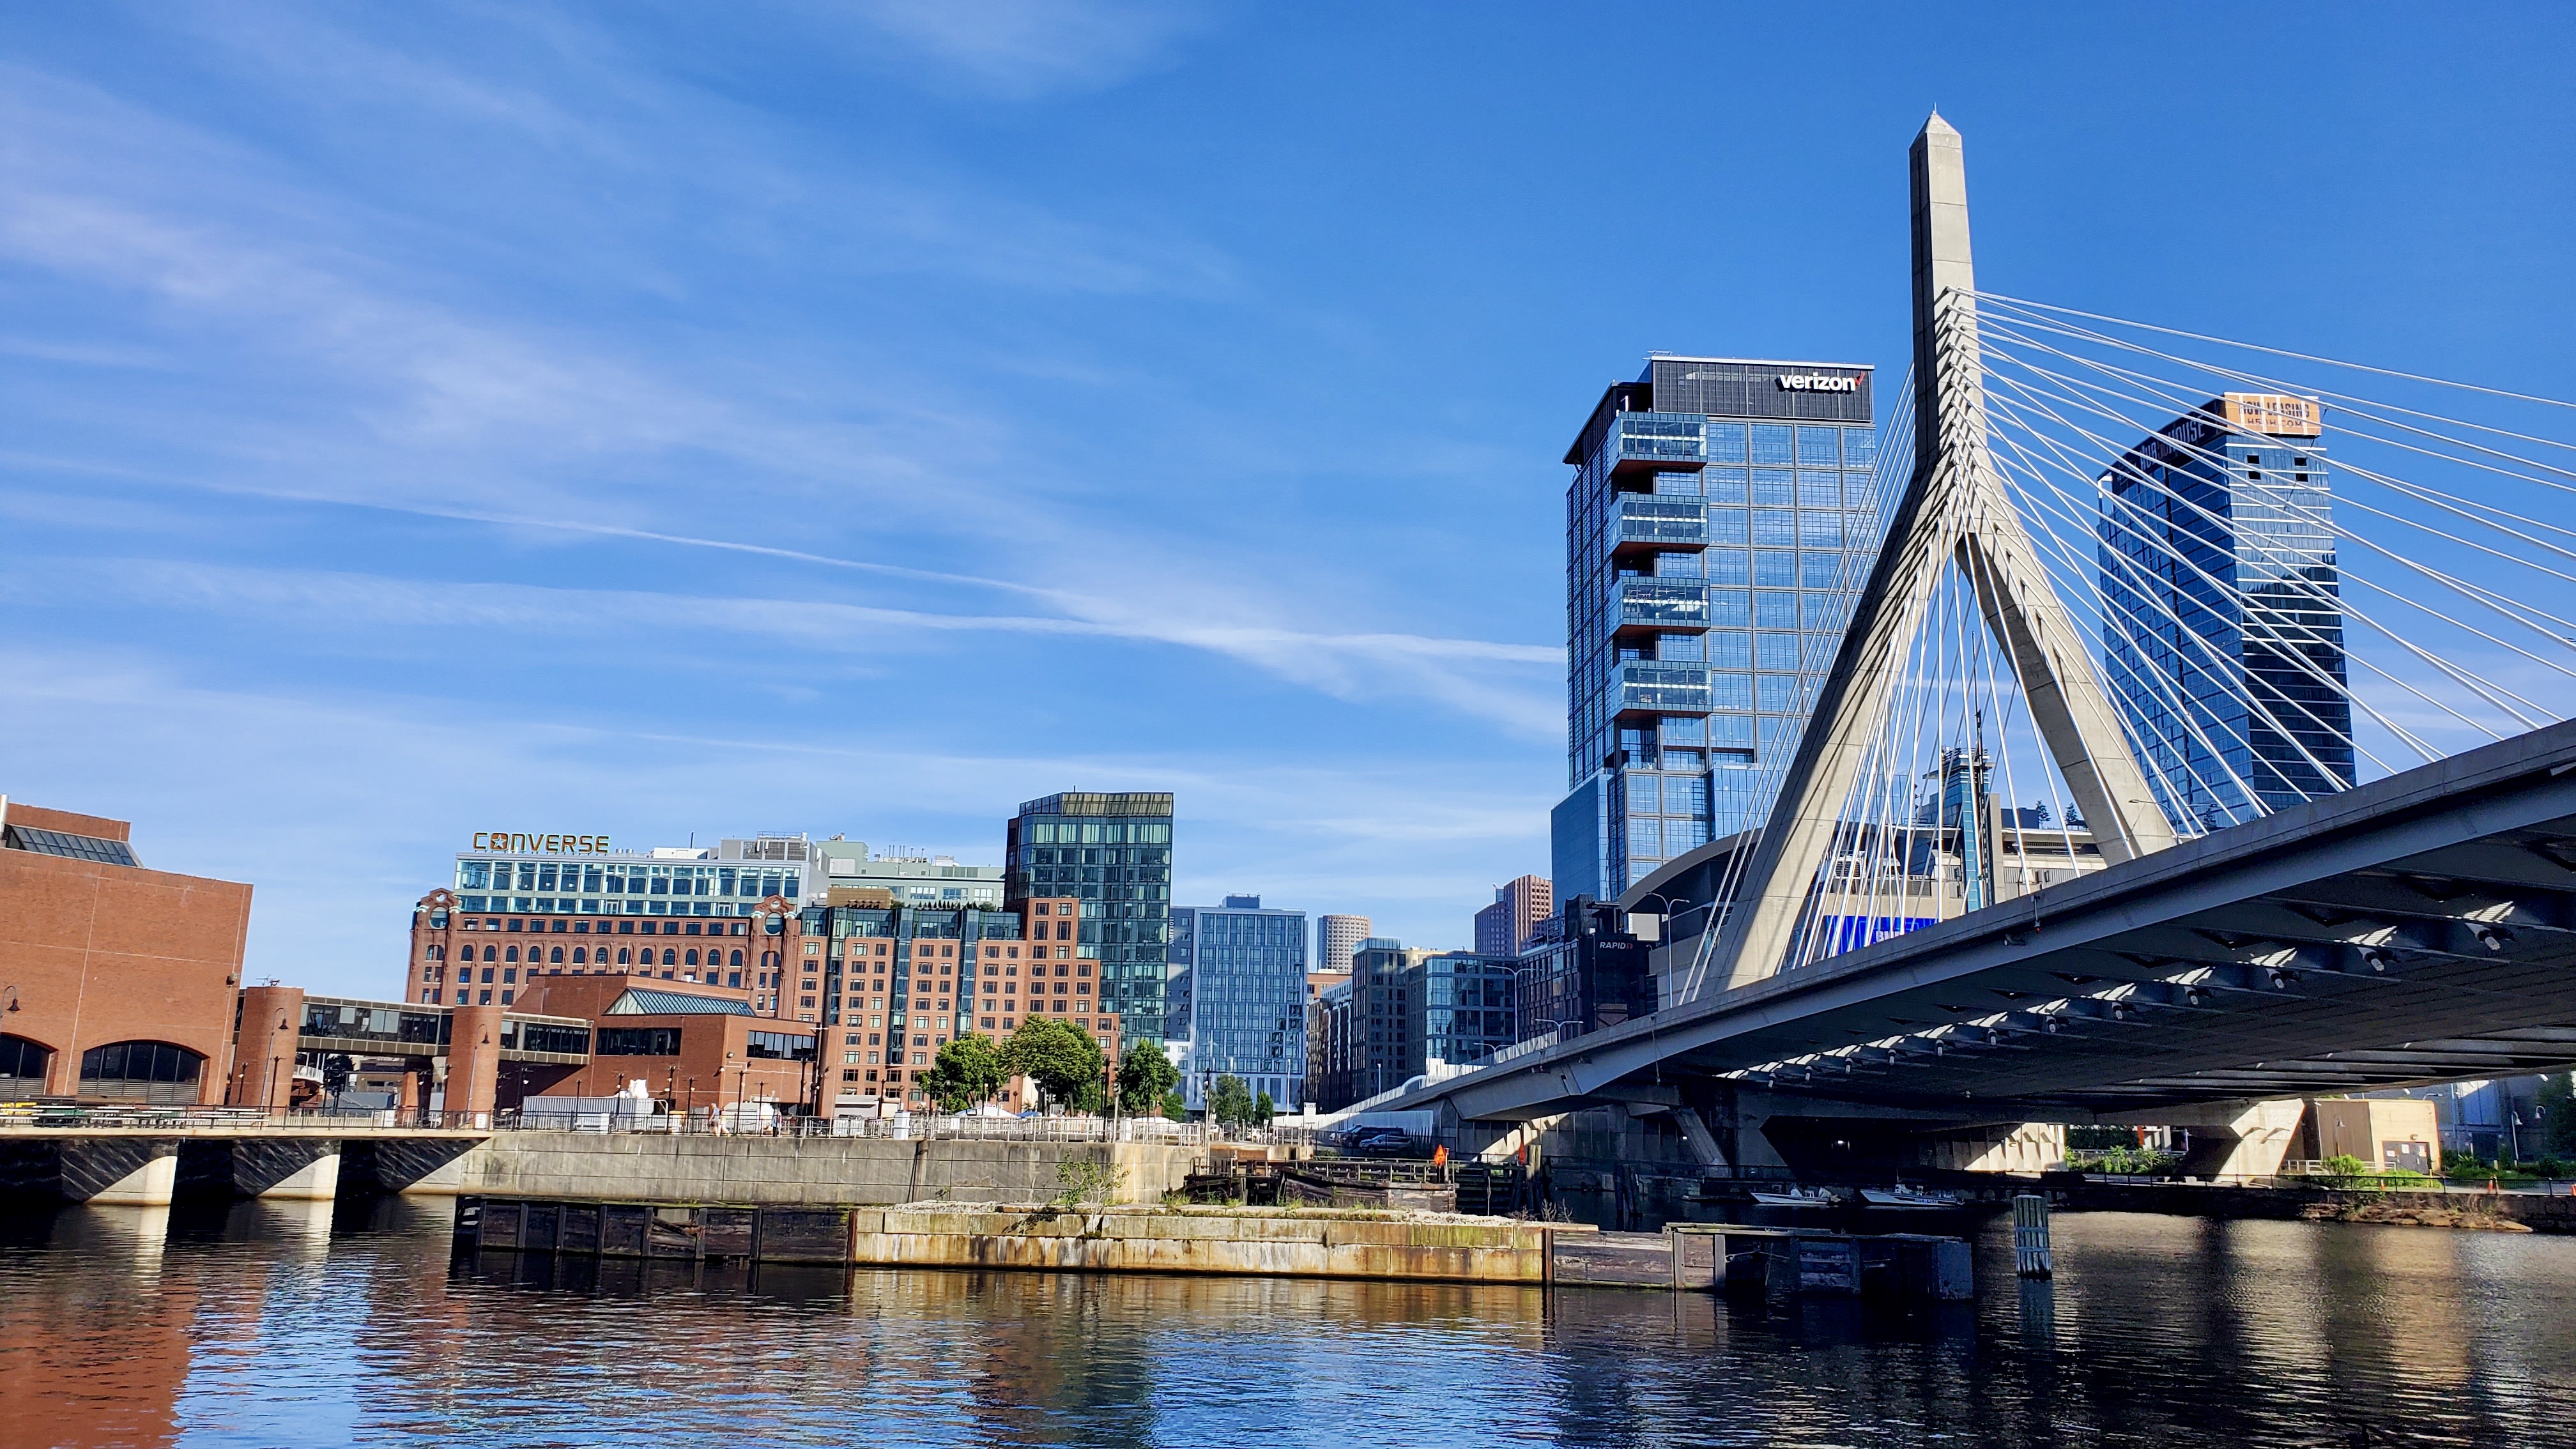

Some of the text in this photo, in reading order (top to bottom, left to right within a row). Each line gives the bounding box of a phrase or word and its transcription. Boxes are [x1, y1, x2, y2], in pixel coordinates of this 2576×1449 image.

[1779, 372, 1855, 391] verizon
[2267, 402, 2310, 418] LEASING
[2248, 418, 2303, 427] H5HCOM
[473, 832, 610, 854] CONVERSE
